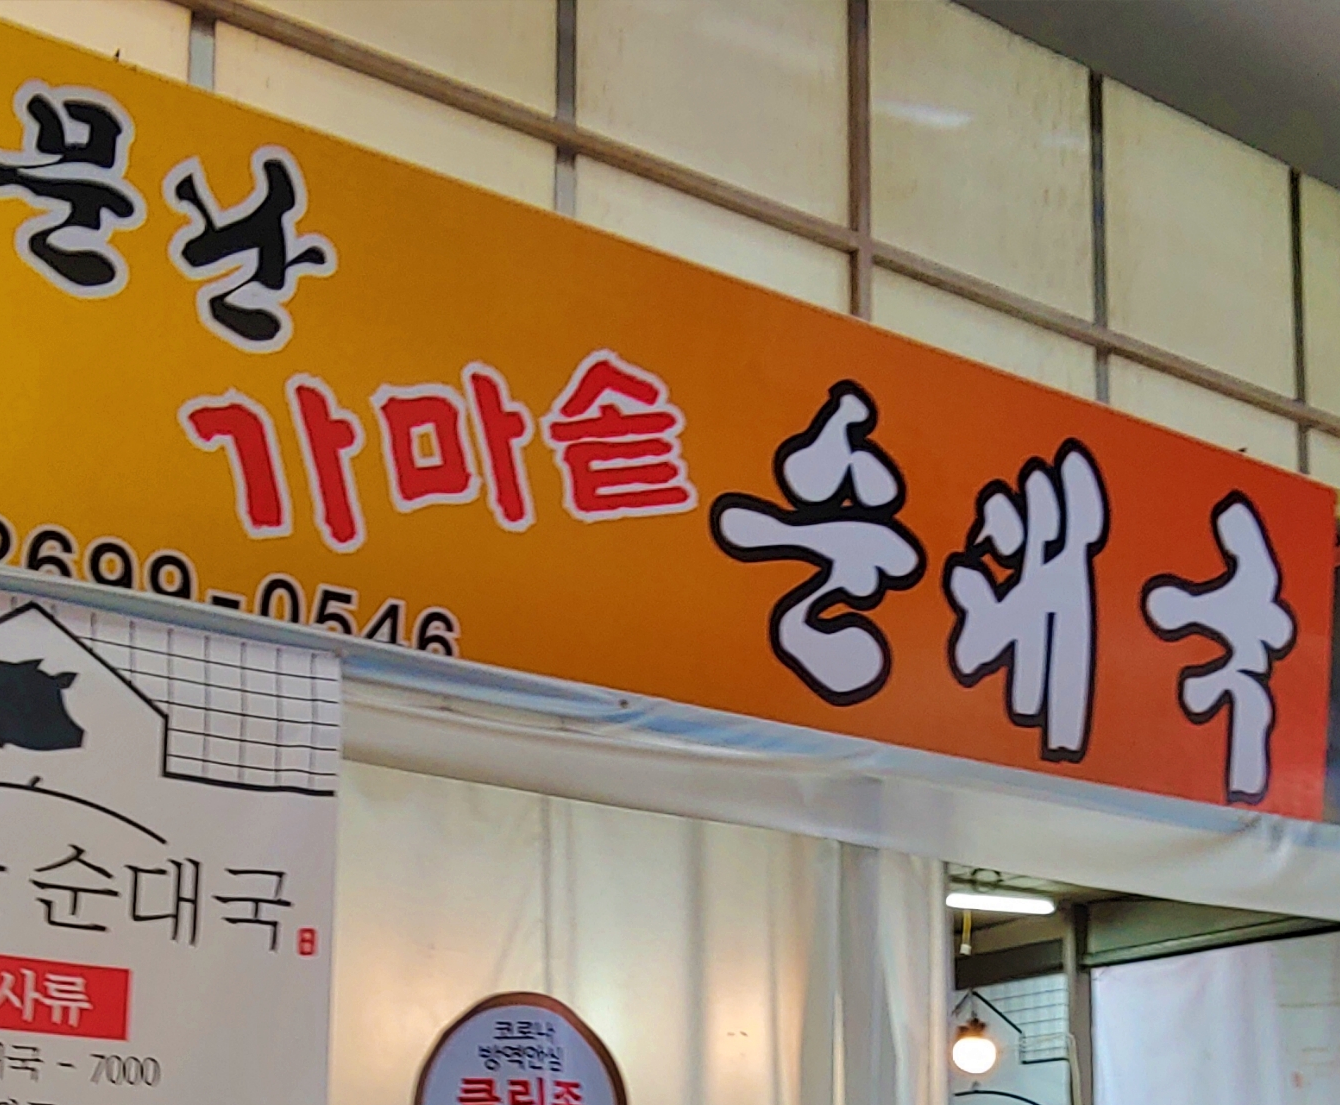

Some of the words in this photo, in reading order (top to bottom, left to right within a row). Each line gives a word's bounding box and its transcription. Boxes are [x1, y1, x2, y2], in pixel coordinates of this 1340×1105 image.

[178, 349, 698, 553] 가마솥
[28, 843, 294, 952] 순대국
[493, 1020, 556, 1044] 코로나
[89, 1053, 160, 1087] 7000
